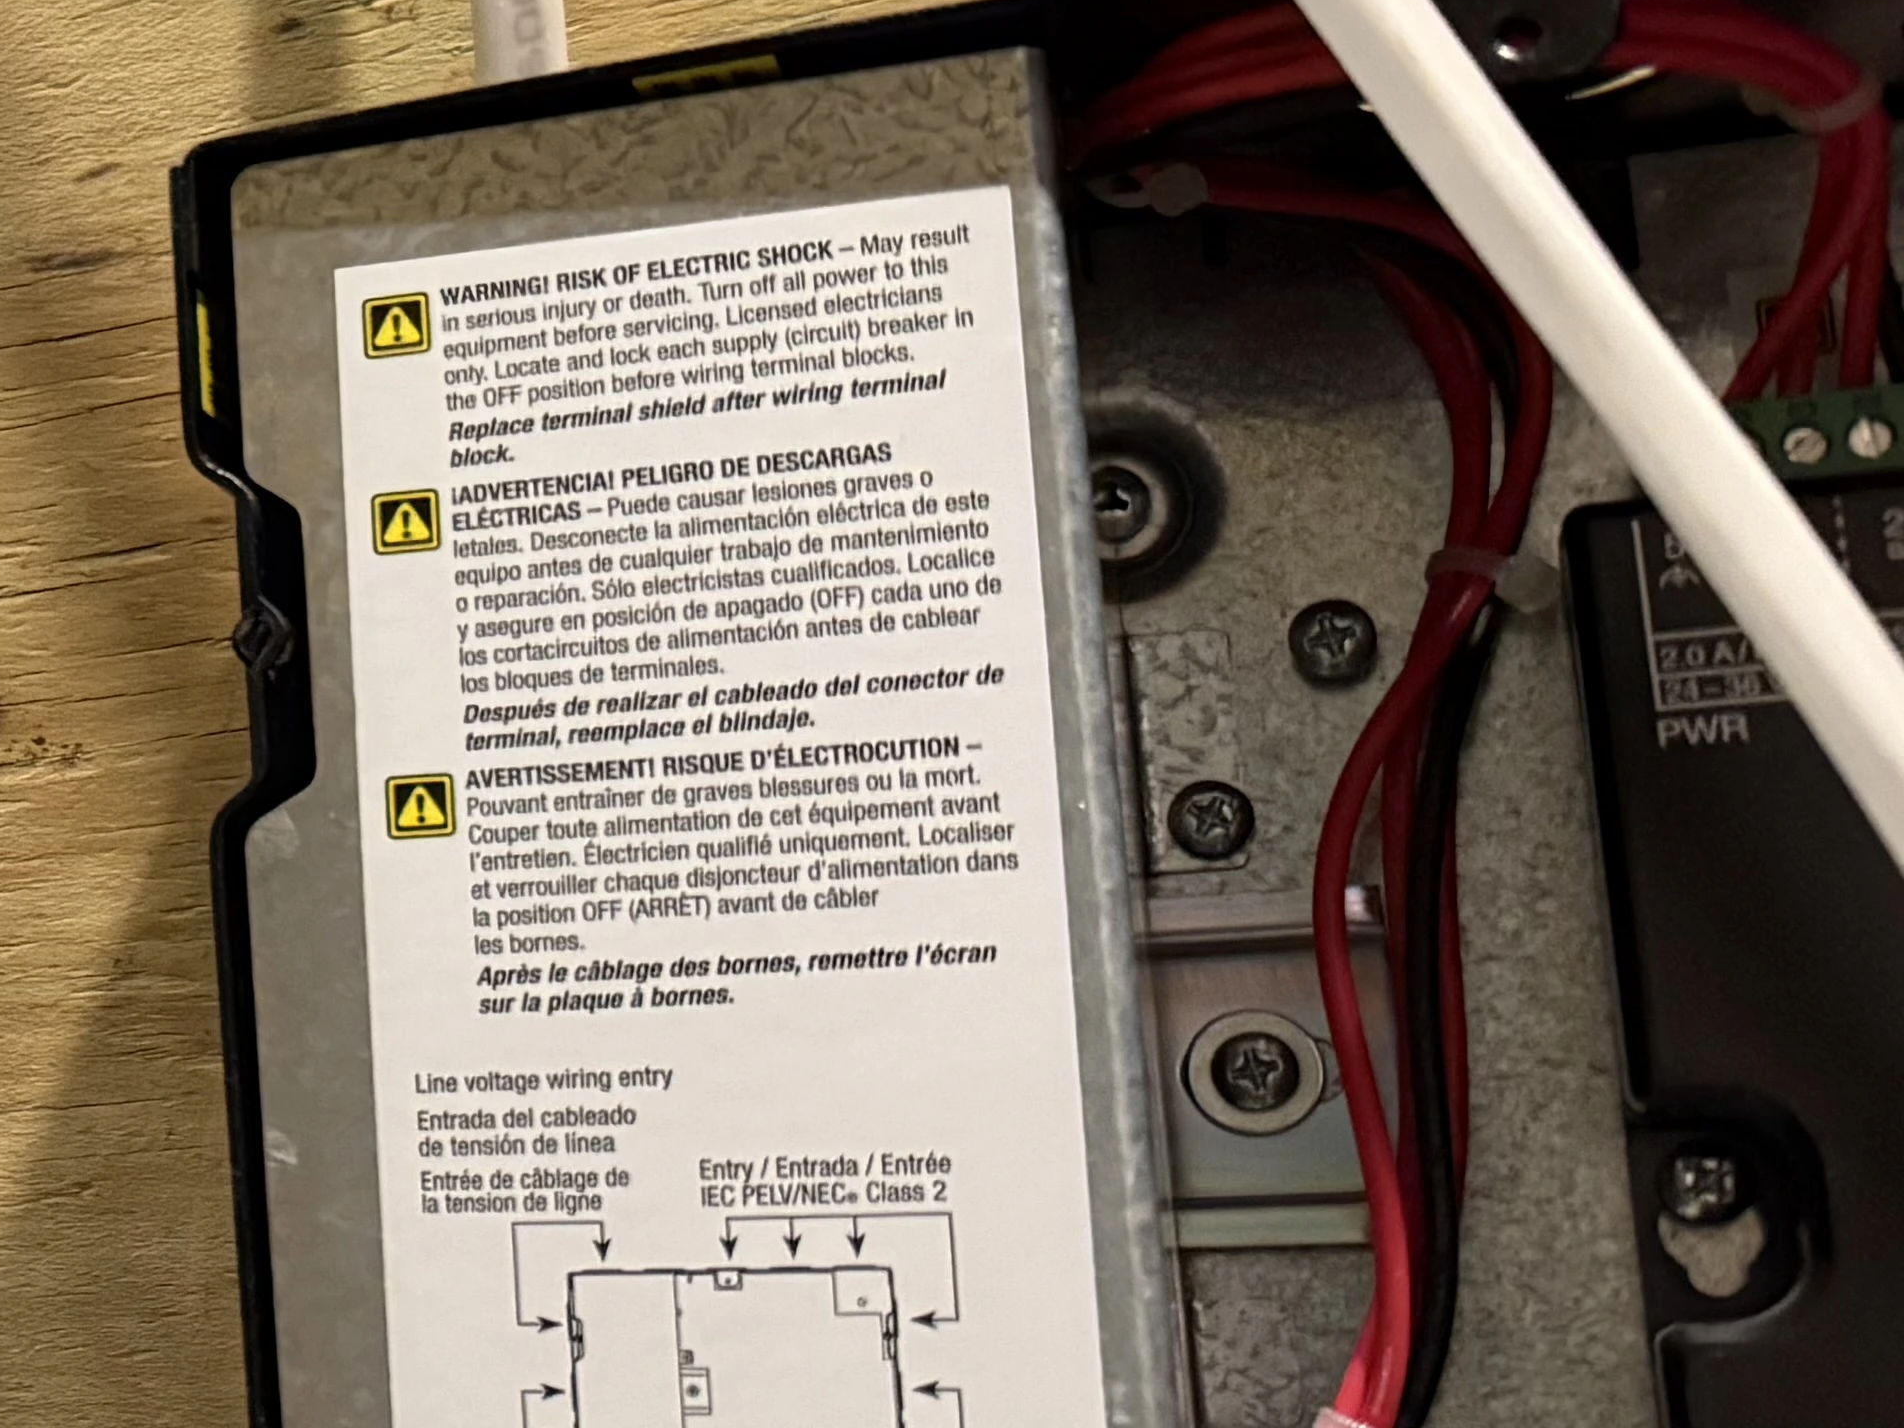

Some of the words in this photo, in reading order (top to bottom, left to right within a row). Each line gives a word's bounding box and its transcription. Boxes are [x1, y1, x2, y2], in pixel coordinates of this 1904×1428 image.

[438, 275, 550, 305] WARNING!
[555, 268, 607, 292] RISK
[611, 264, 642, 285] OF
[646, 251, 751, 281] ELECTRIC
[756, 241, 834, 268] SHOCK
[859, 232, 905, 260] May
[910, 225, 970, 250] result
[441, 313, 460, 333] in
[465, 304, 537, 330] serious
[542, 297, 598, 325] injury
[602, 298, 624, 314] or
[628, 285, 692, 311] death.
[696, 279, 744, 303] Turn
[748, 275, 778, 297] off
[782, 272, 807, 293] all
[812, 268, 879, 294] power
[883, 260, 905, 281] to
[909, 255, 949, 278] this
[442, 328, 549, 363] equipment
[553, 320, 618, 346] before
[622, 309, 720, 342] servicing.
[725, 297, 818, 326] Licensed
[822, 283, 944, 315] electricians
[443, 361, 489, 388] only.
[493, 353, 561, 378] Locate
[565, 348, 605, 370] and
[609, 343, 652, 365] lock
[656, 337, 706, 360] each
[711, 328, 780, 359] supply
[783, 319, 862, 351] (circuit)
[866, 309, 949, 337] breaker
[953, 307, 974, 327] in
[444, 389, 478, 411] the
[481, 384, 523, 407] OFF
[526, 375, 606, 406] position
[610, 368, 677, 393] before
[679, 360, 745, 390] wiring
[749, 350, 836, 378] terminal
[841, 342, 915, 368] blocks.
[447, 414, 536, 445] Replace
[540, 403, 634, 431] terminal
[637, 395, 708, 421] shield
[710, 389, 768, 413] after
[771, 381, 844, 411] wiring
[850, 370, 948, 399] terminal
[448, 443, 516, 467] block.
[450, 470, 615, 504] ¡ADVERTENCIA!
[620, 460, 715, 488] PELIGRO
[719, 457, 751, 478] DE
[755, 443, 893, 475] DESCARGAS
[463, 757, 655, 789] AVERTISSEMENT!
[661, 751, 745, 776] RISQUE
[749, 732, 960, 770] D'ÉLECTROCUTION
[1656, 714, 1749, 749] PWR
[414, 1073, 459, 1093] Line
[463, 1070, 541, 1096] voltage
[545, 1068, 613, 1093] wiring
[617, 1066, 674, 1091] entry
[416, 1109, 496, 1131] Entrada
[501, 1108, 534, 1128] del
[539, 1105, 637, 1127] cableado
[698, 1159, 755, 1184] Entry
[775, 1156, 860, 1178] Entrada
[880, 1153, 953, 1175] Entrée
[700, 1187, 737, 1207] IEC
[864, 1182, 926, 1203] Class
[931, 1181, 948, 1201] 2
